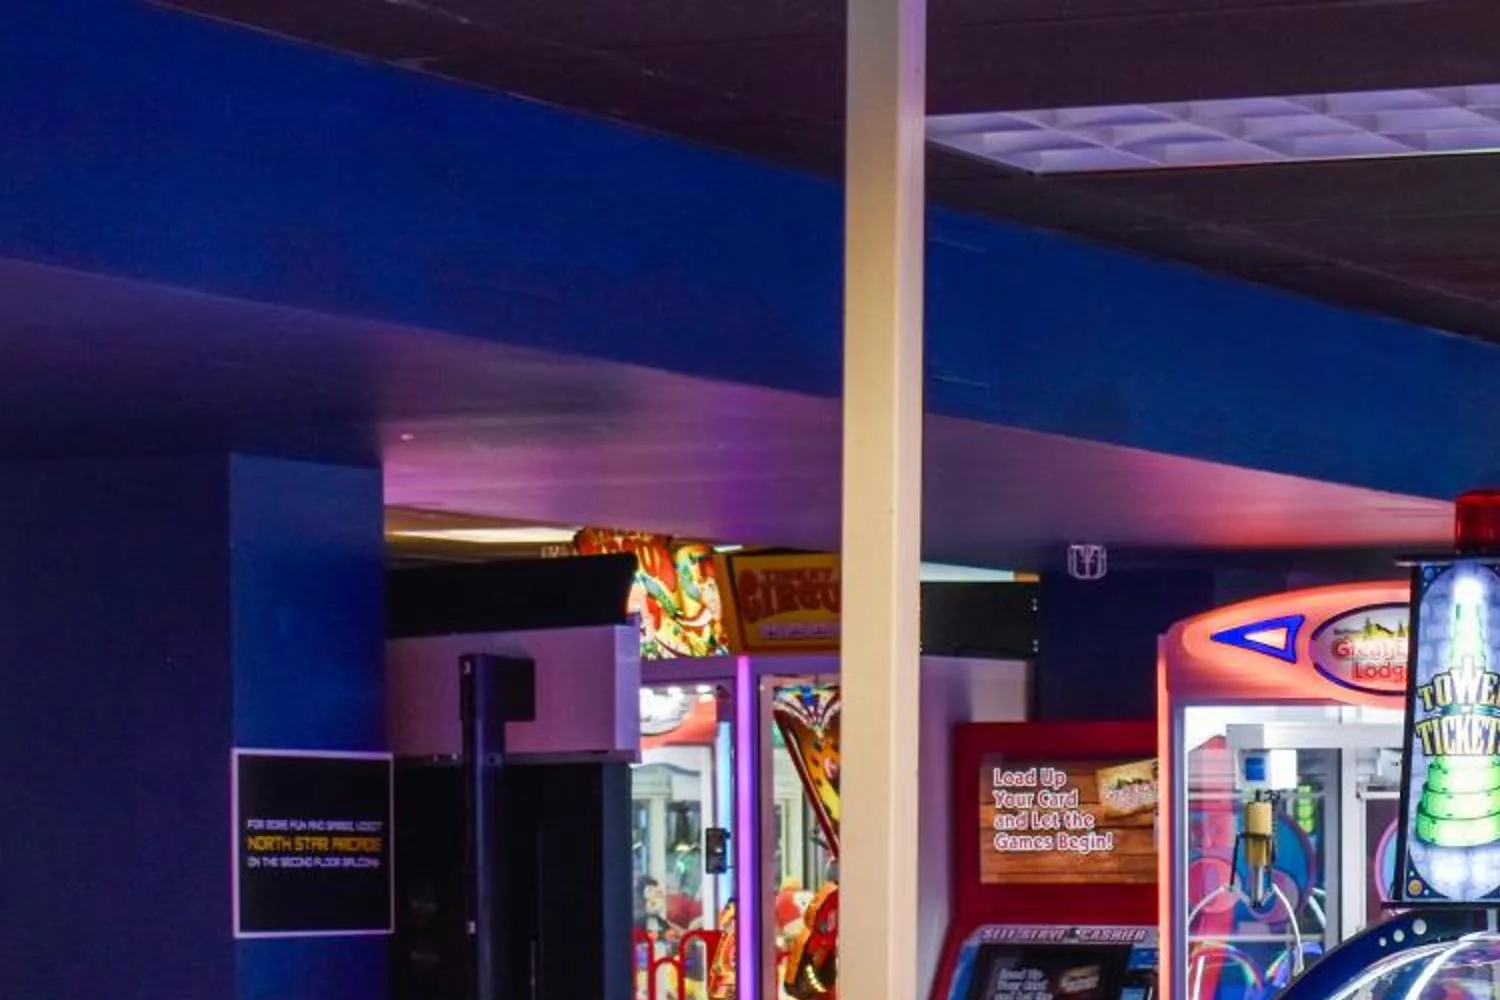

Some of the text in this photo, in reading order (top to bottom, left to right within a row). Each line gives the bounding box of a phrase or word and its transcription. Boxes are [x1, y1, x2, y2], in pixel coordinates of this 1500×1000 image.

[1353, 661, 1408, 685] Lodg
[993, 768, 1067, 790] Load Up
[992, 788, 1079, 809] Your Card
[993, 811, 1095, 830] and Let the
[247, 835, 292, 851] NORTH
[294, 835, 329, 851] STAR
[993, 831, 1114, 854] Games Begin!
